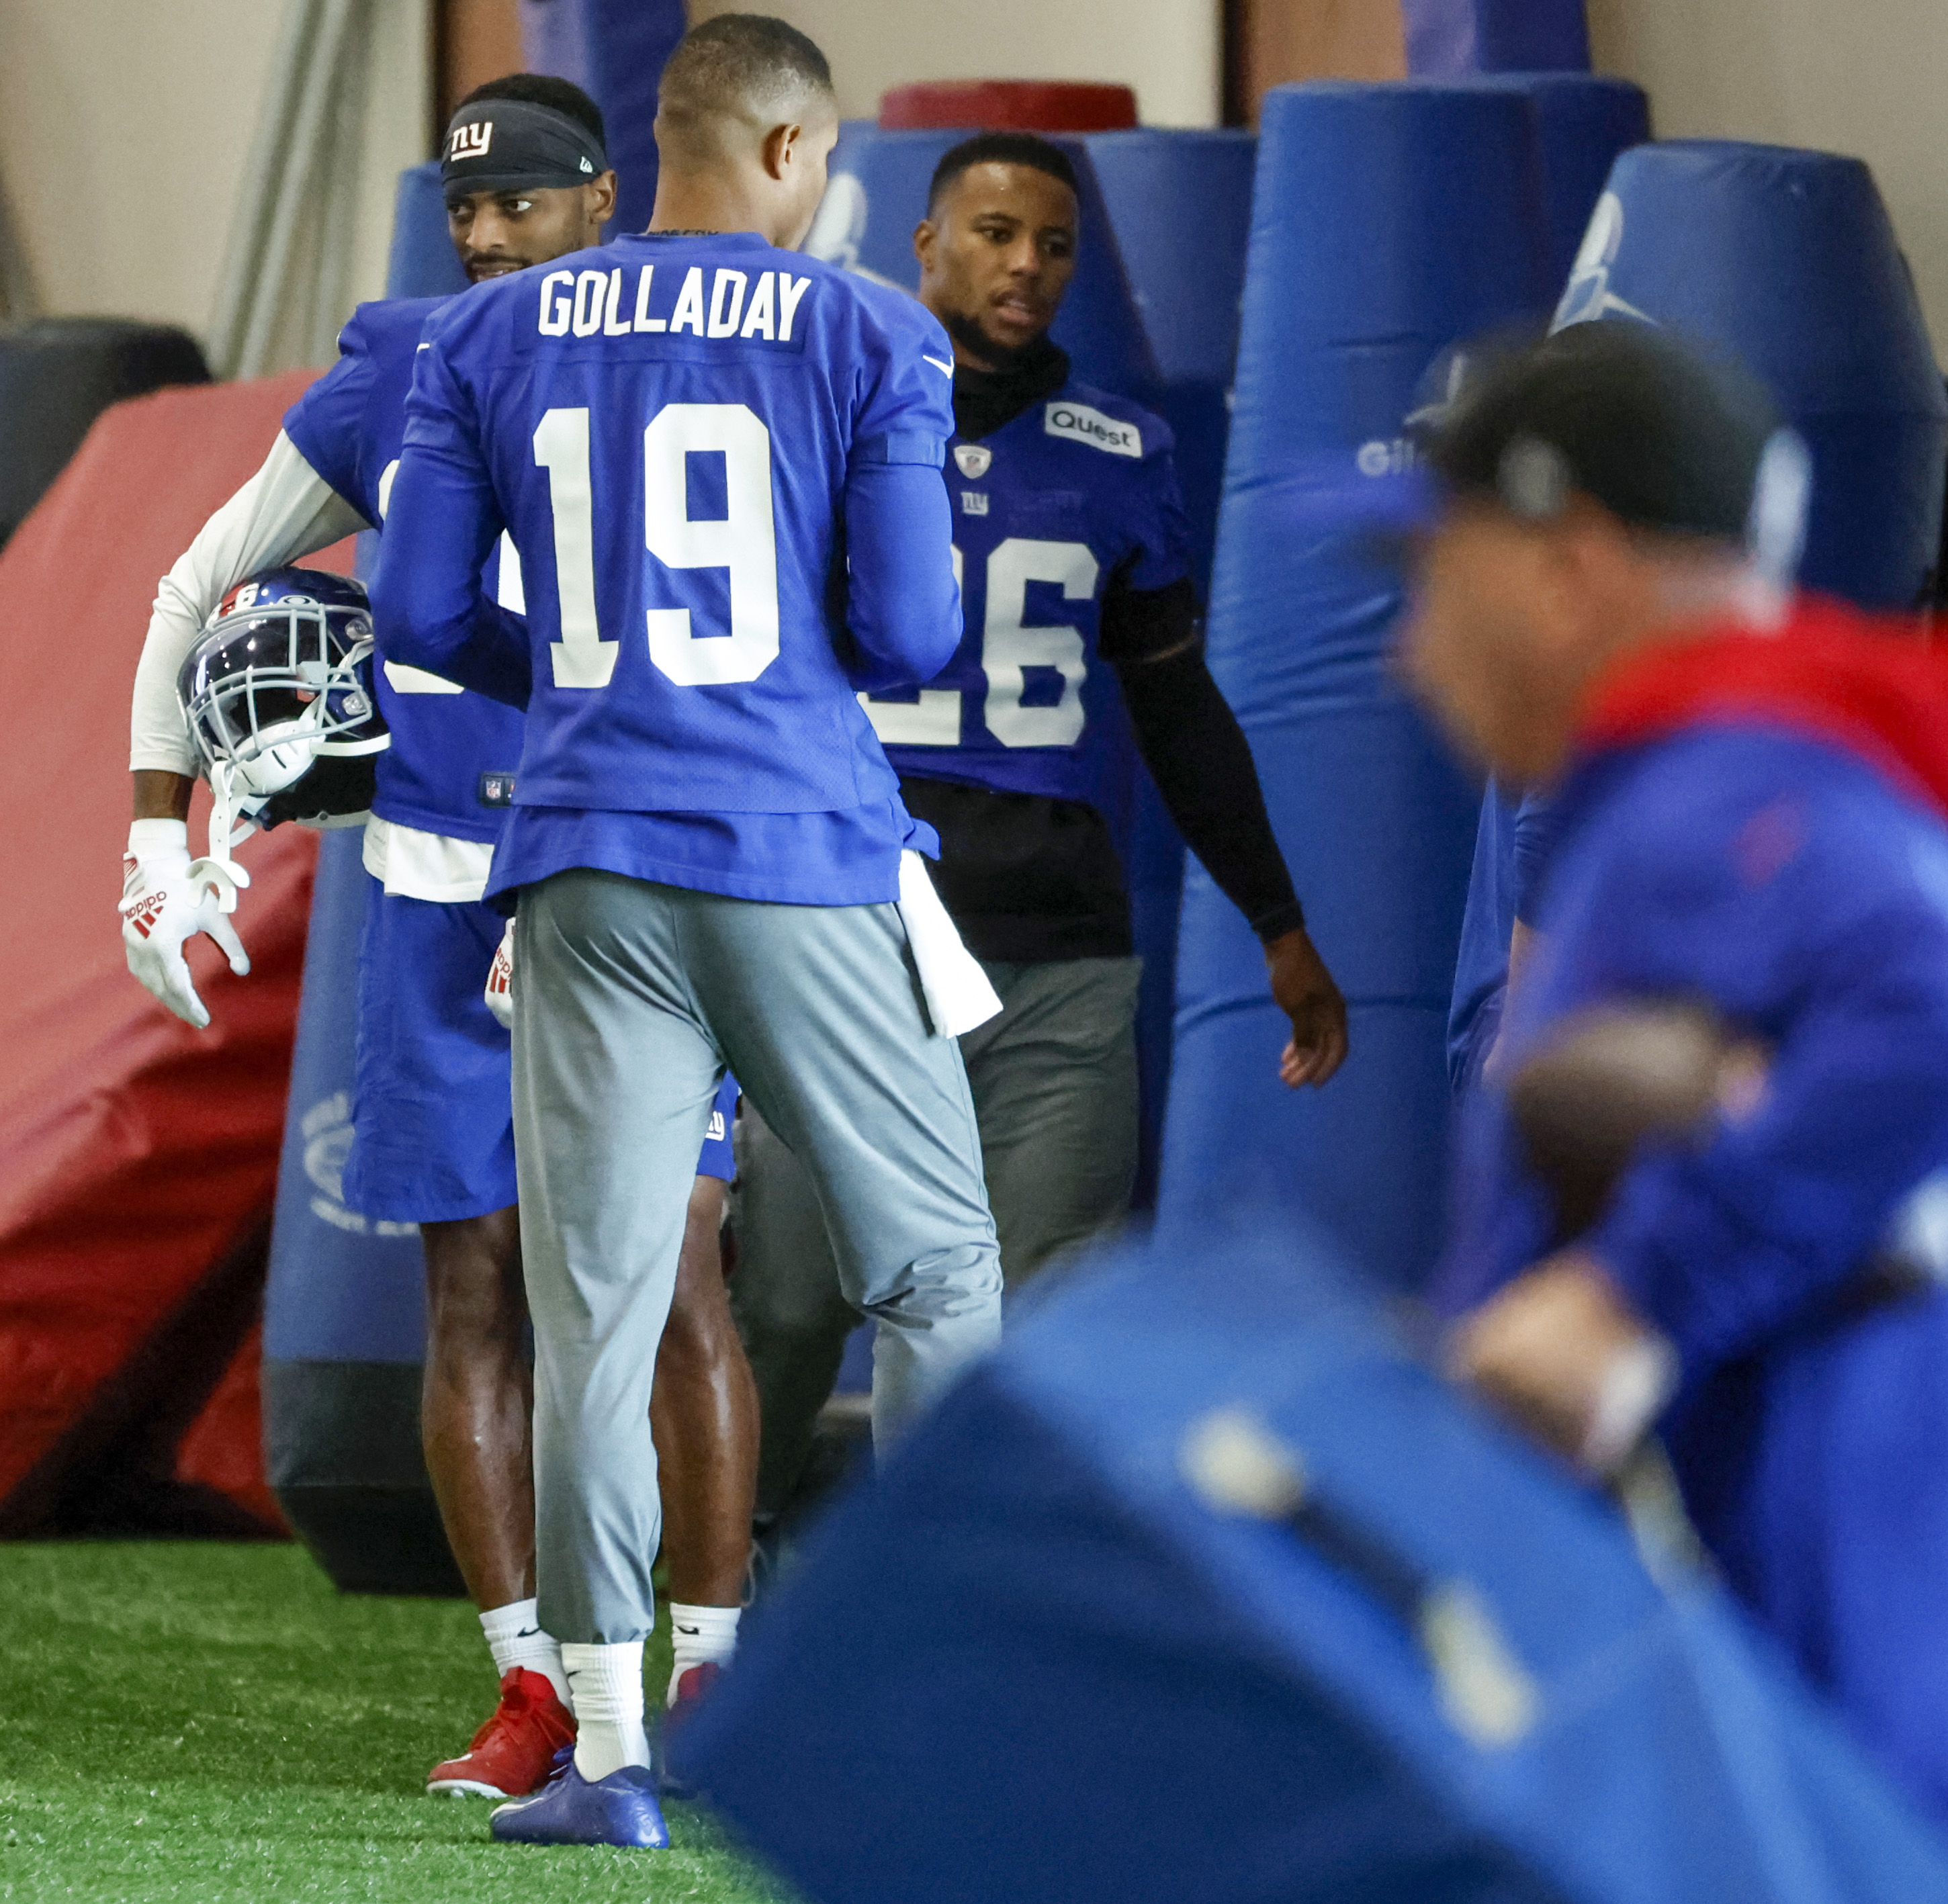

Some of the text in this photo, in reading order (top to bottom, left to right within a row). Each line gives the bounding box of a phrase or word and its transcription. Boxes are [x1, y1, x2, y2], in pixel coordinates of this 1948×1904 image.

[539, 265, 811, 341] GOLLADAY
[1053, 410, 1130, 447] Quest
[533, 404, 780, 688] 19
[125, 891, 167, 919] adidas
